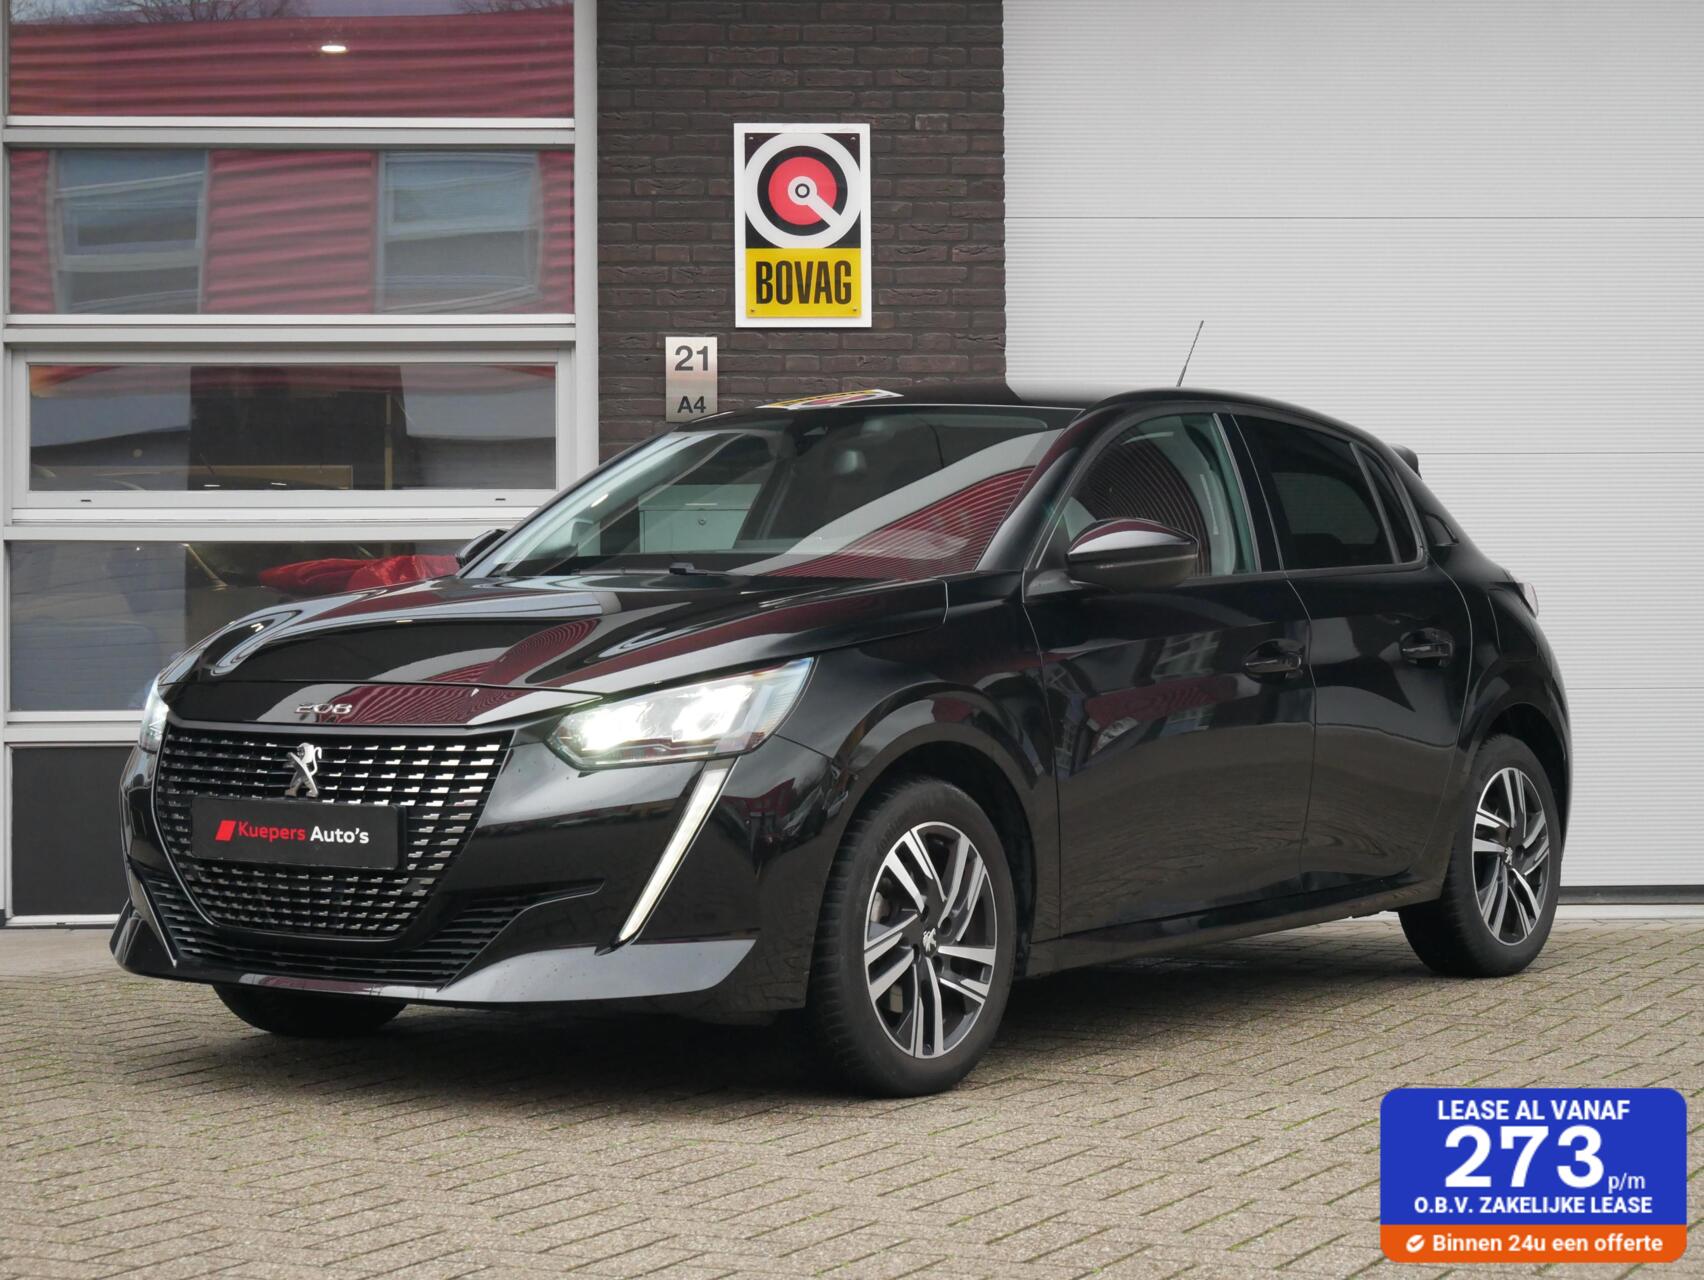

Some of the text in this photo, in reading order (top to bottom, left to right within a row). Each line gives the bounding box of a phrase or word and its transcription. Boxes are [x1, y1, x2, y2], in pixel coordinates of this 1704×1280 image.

[755, 260, 852, 305] BOVAG
[674, 345, 709, 371] 21
[677, 396, 706, 414] A4
[294, 703, 353, 715] 208
[238, 821, 370, 844] Kuepers Auto's
